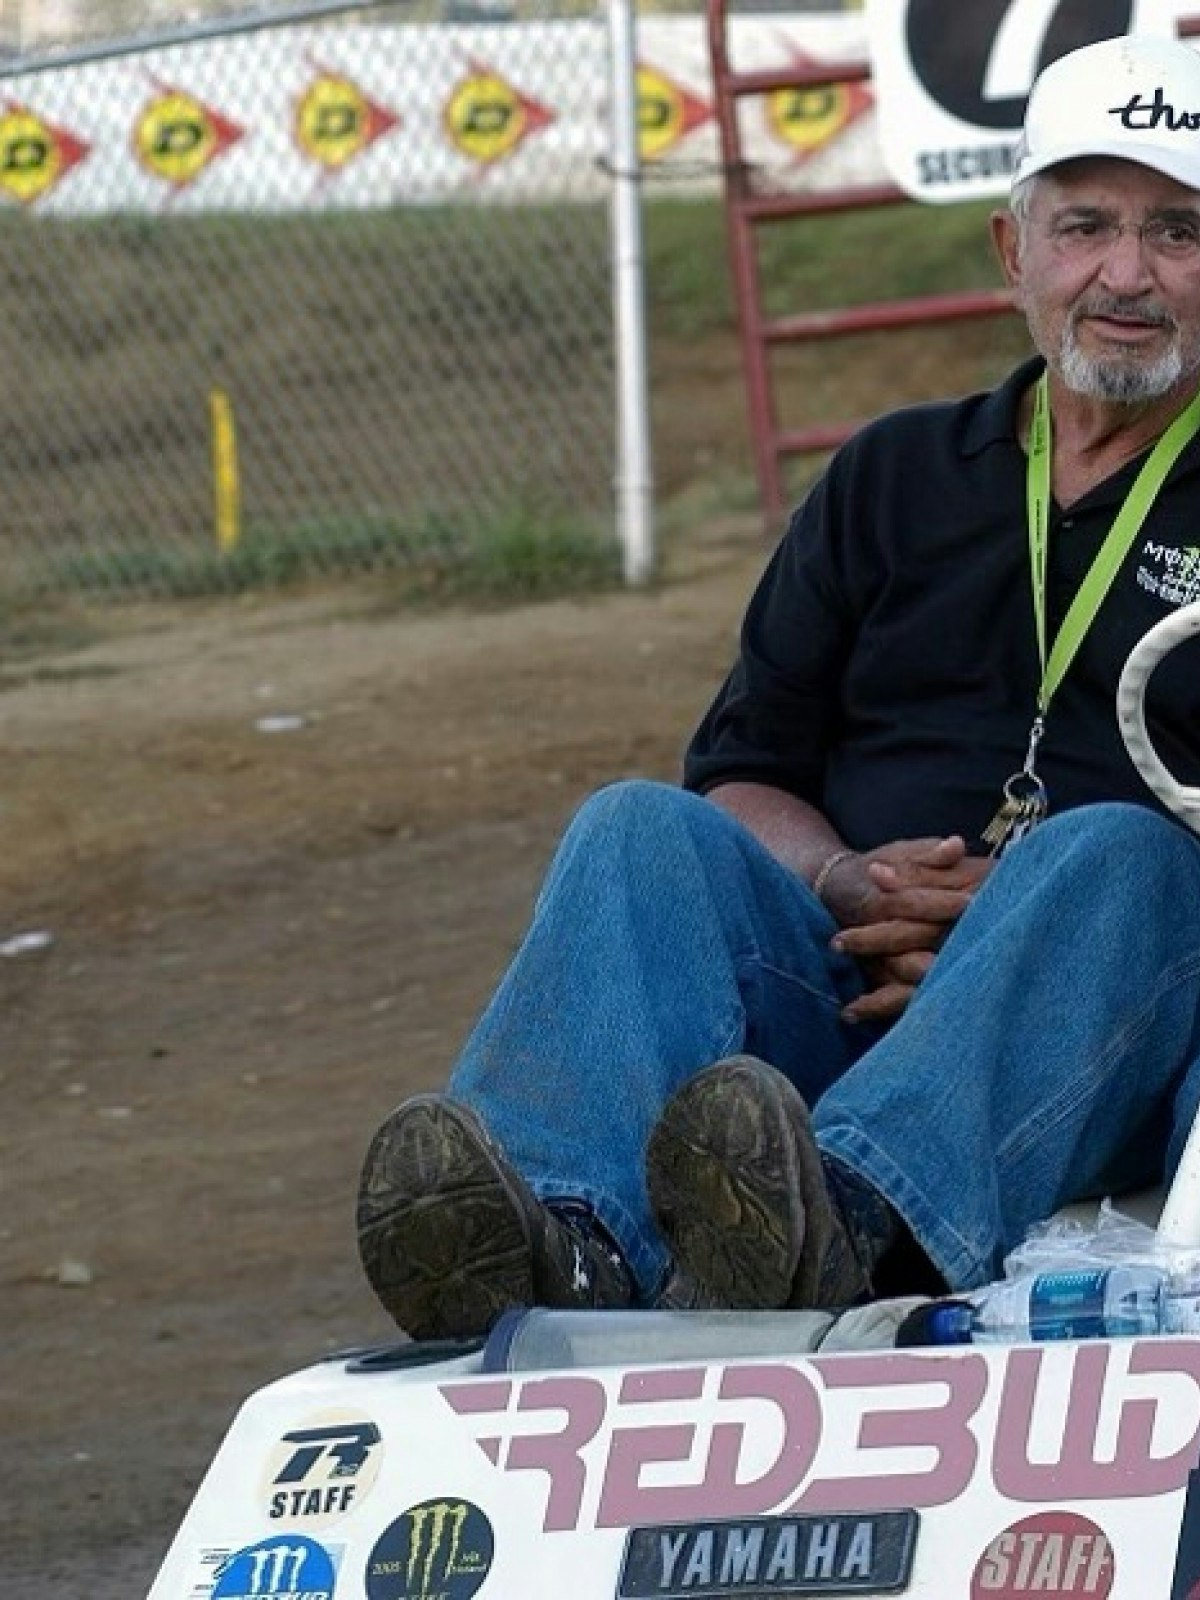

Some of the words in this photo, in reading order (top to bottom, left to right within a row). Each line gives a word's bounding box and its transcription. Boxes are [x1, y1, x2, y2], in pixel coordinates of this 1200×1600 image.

[916, 145, 1021, 186] SECUR
[269, 1483, 356, 1519] STAFF
[658, 1521, 873, 1588] YAMAHA
[980, 1532, 1111, 1592] STAFF
